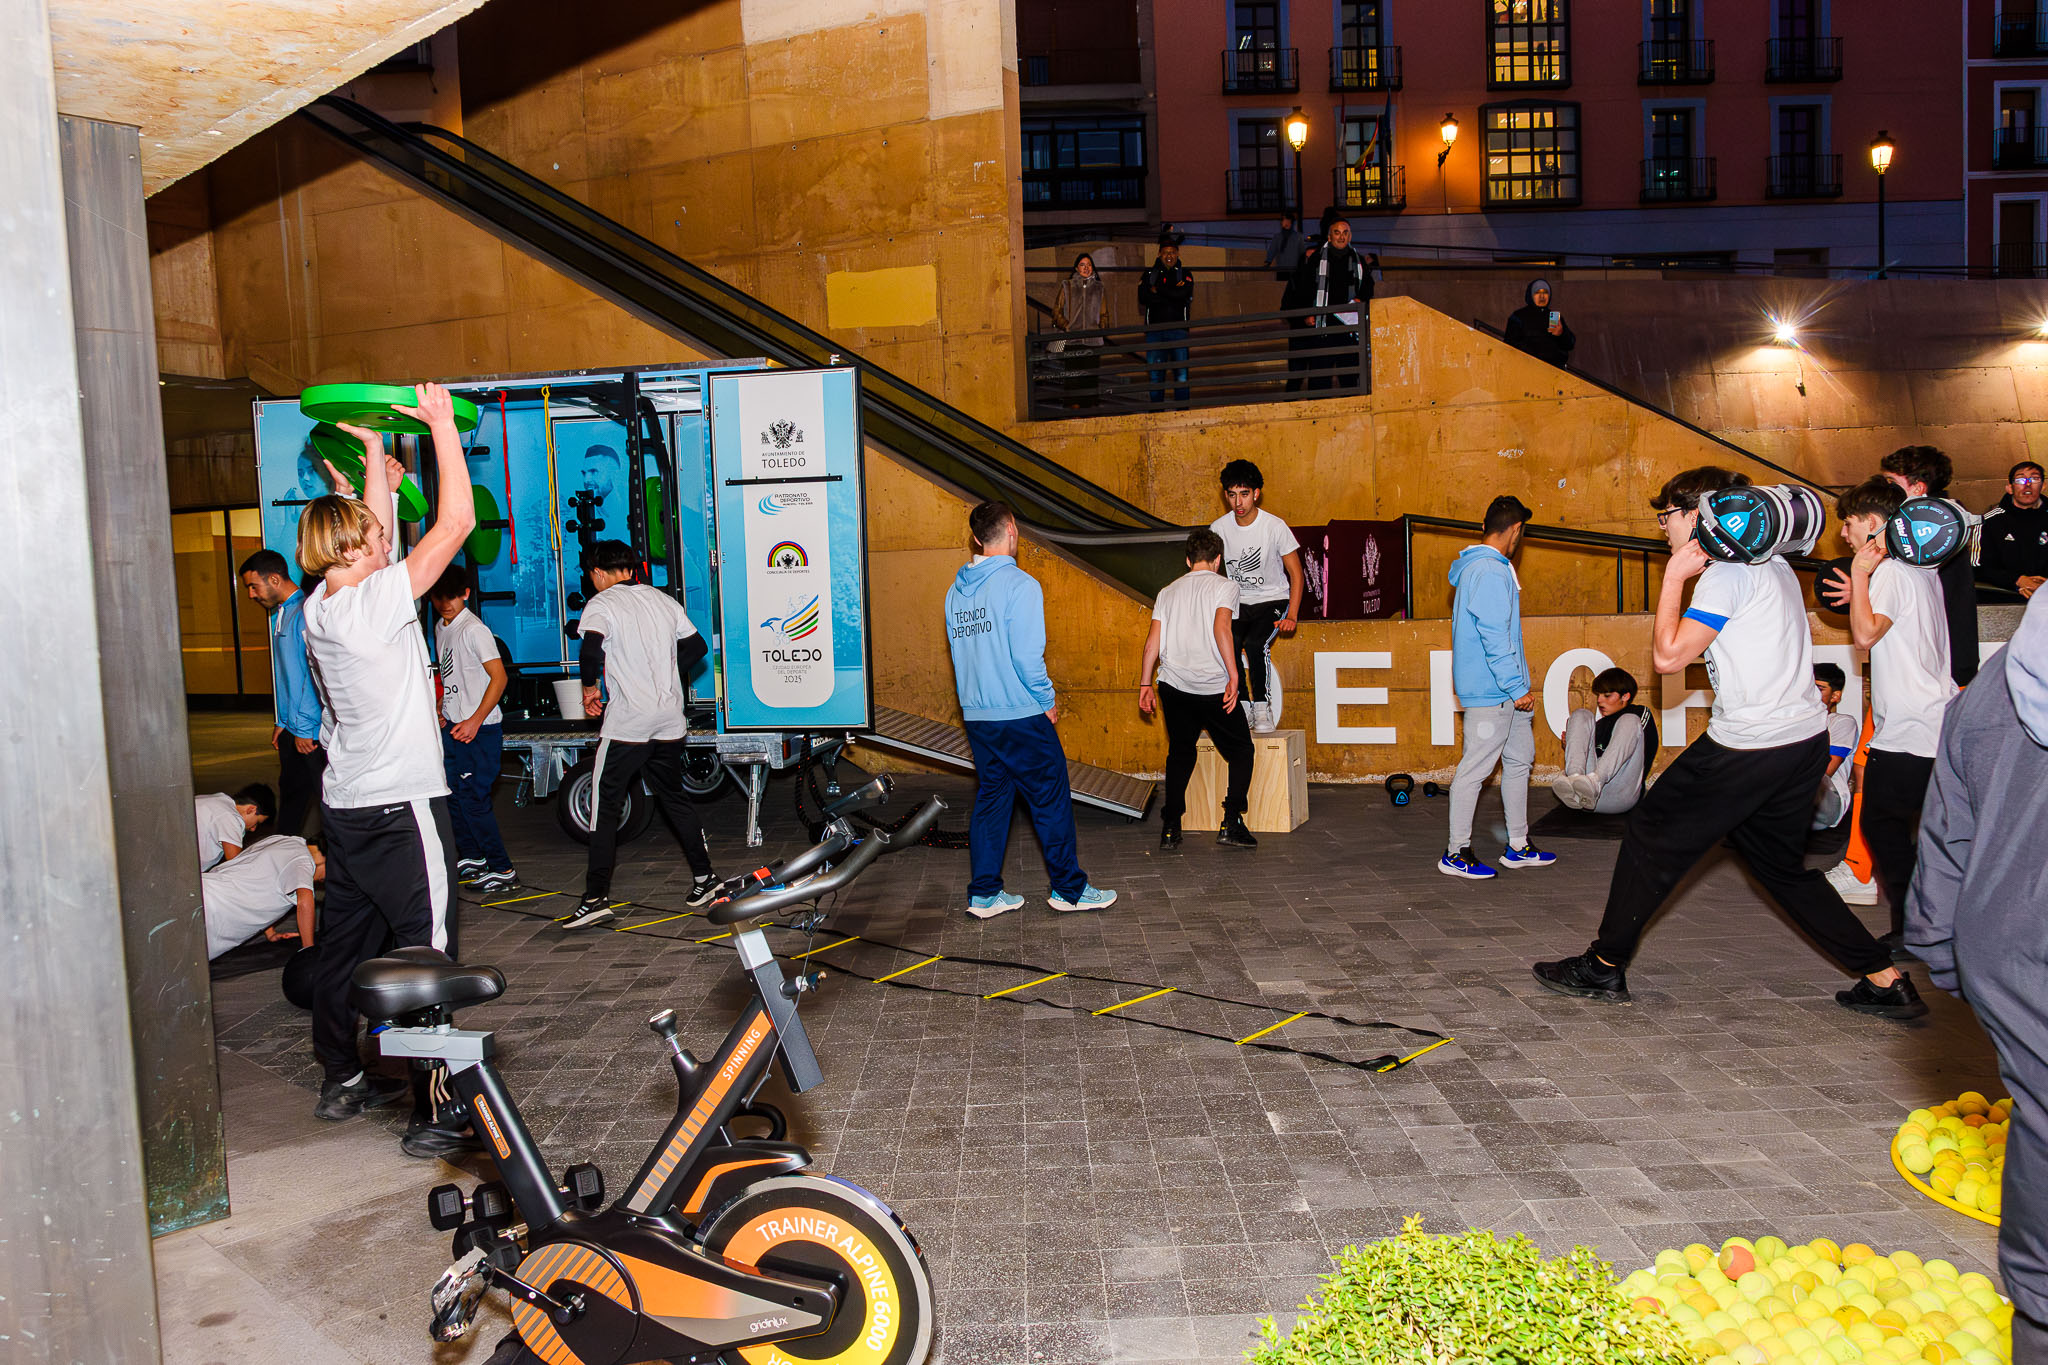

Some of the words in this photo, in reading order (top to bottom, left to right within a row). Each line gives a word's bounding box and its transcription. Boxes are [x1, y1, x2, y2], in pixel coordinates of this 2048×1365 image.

[761, 457, 806, 468] TOLEDO
[1726, 515, 1745, 533] 10
[1917, 526, 1932, 537] 5
[952, 620, 992, 639] DEPORTIVO
[761, 649, 822, 663] TOLEDO
[784, 675, 802, 683] 2025
[722, 1029, 761, 1081] SPINNING
[755, 1216, 839, 1243] TRAINER
[838, 1235, 889, 1300] ALPINE
[865, 1301, 892, 1351] 6000
